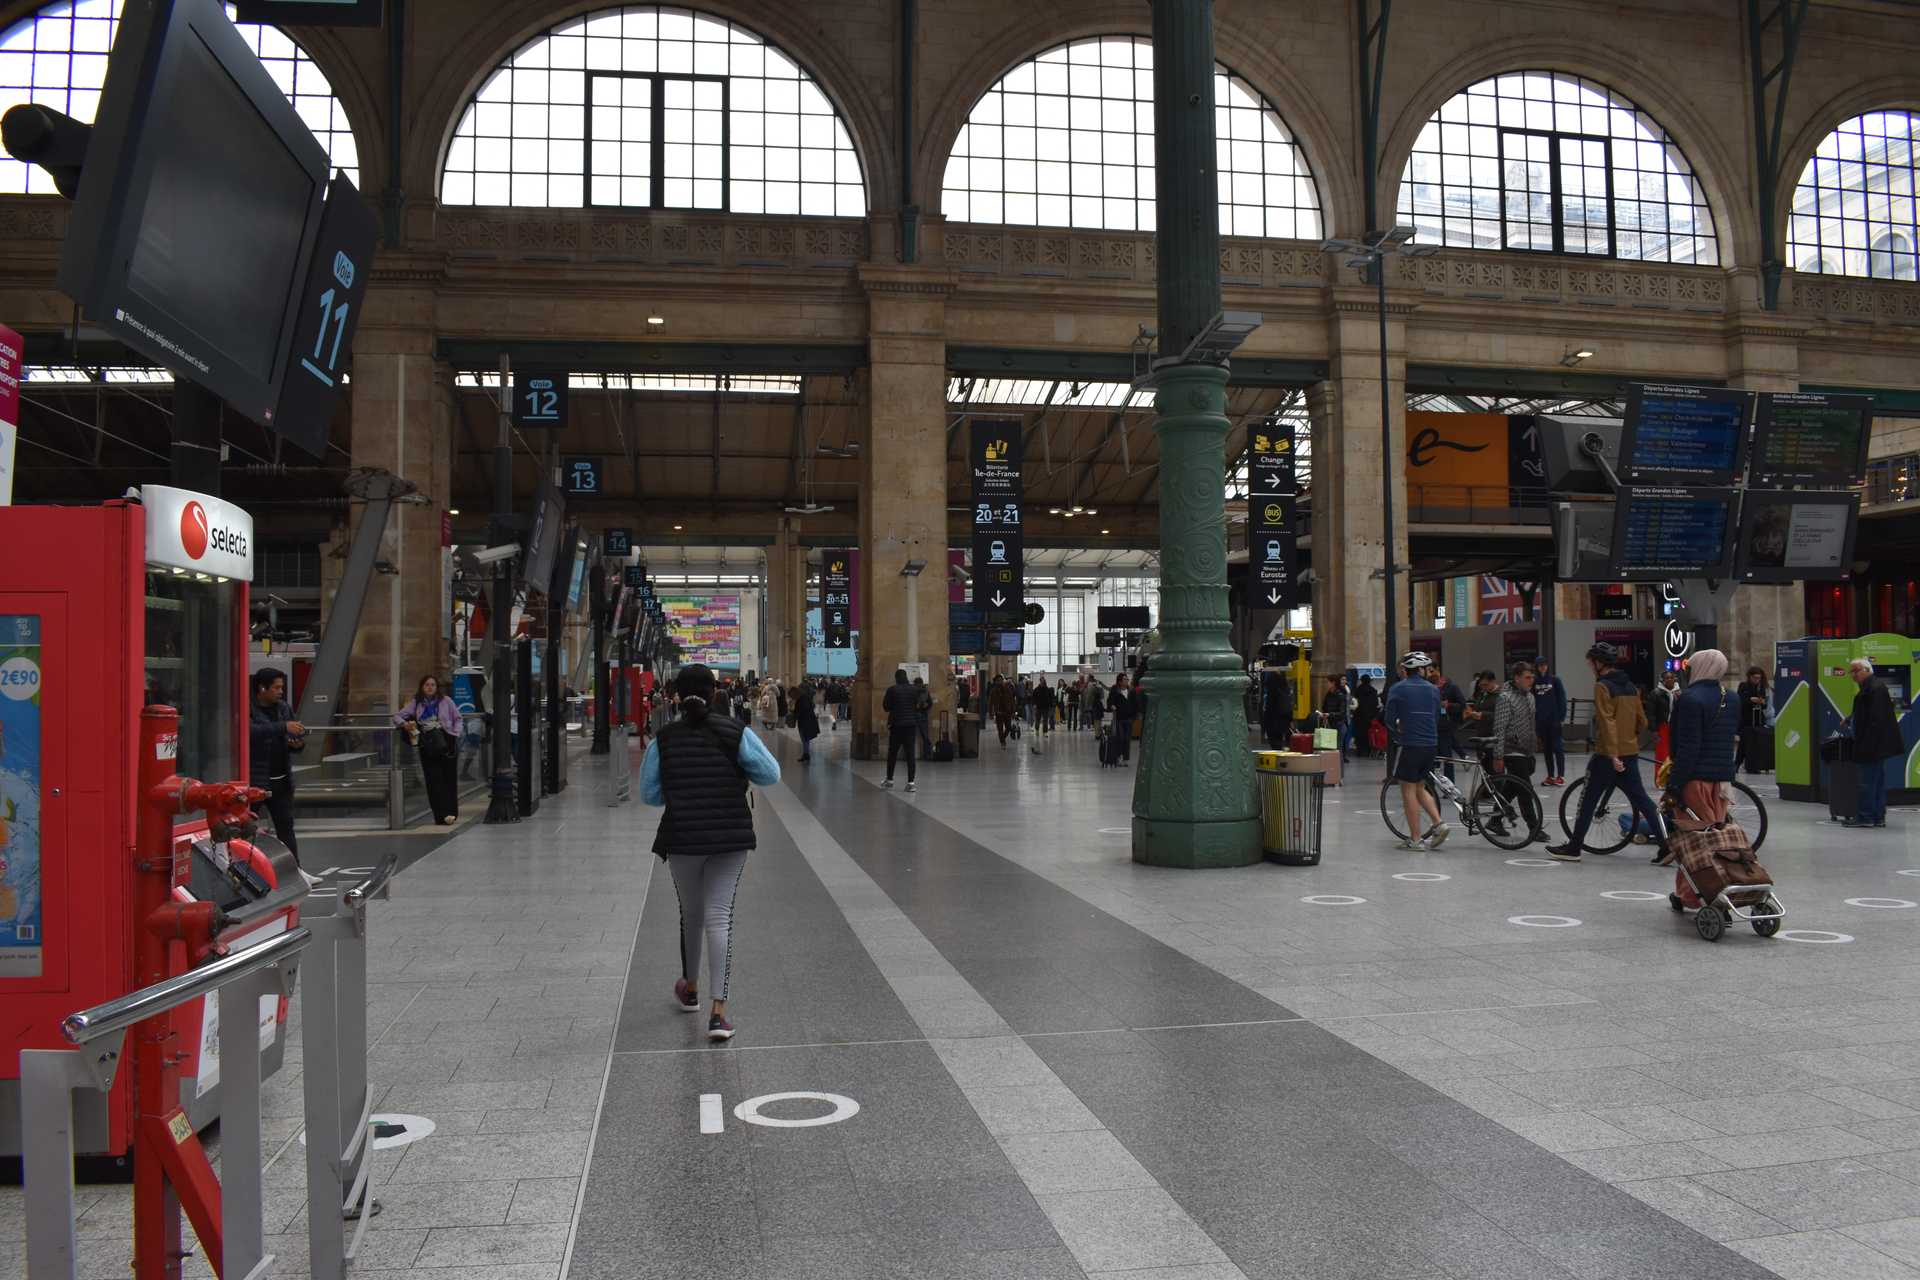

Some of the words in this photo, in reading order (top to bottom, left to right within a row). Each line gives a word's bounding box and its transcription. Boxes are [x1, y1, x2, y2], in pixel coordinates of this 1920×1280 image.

[336, 254, 352, 286] Voie
[313, 287, 350, 371] 11
[531, 380, 552, 389] Voie
[525, 391, 559, 415] 12
[975, 468, 1020, 477] Île-de-France
[571, 471, 597, 489] 13
[976, 509, 992, 521] 20
[1003, 509, 1018, 521] 21
[1267, 508, 1280, 516] BUS
[211, 526, 247, 557] selecta
[610, 537, 627, 550] 14
[639, 585, 650, 595] 16
[645, 599, 656, 608] 17
[1670, 628, 1683, 648] M
[1, 670, 38, 685] 2€90
